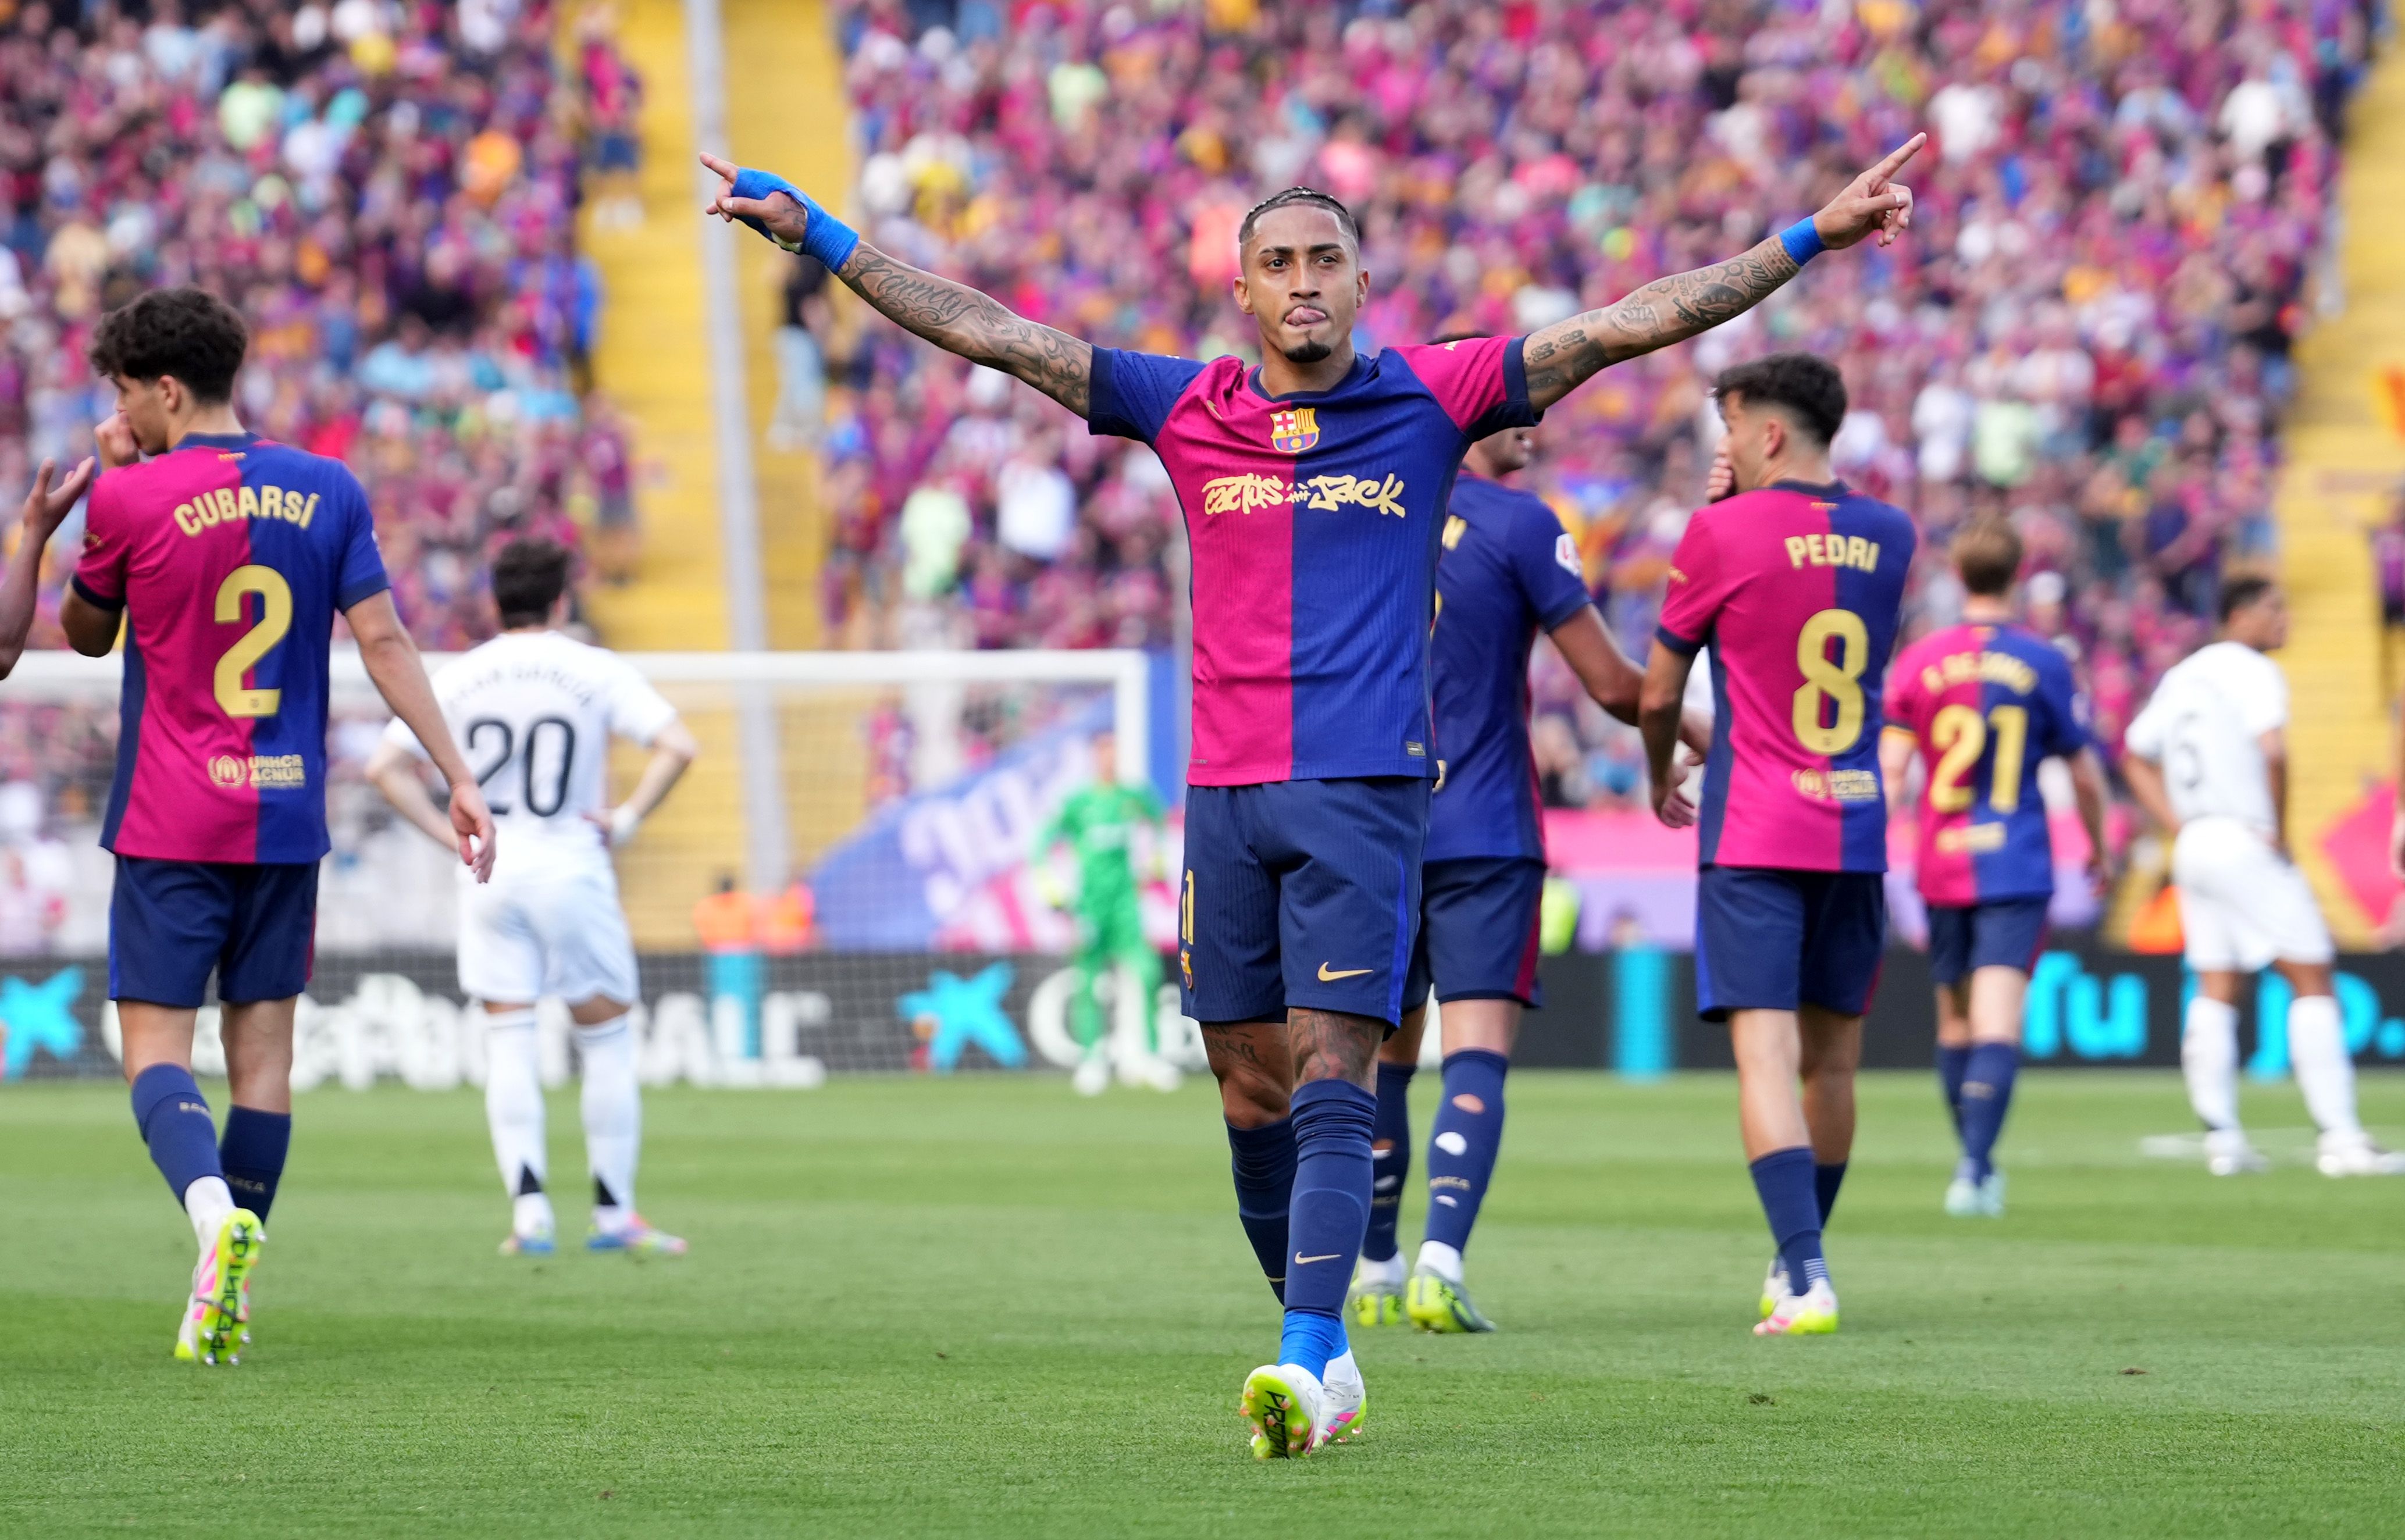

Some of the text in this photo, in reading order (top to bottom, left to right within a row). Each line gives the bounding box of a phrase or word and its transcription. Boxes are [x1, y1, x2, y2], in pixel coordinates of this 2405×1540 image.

[174, 484, 320, 536] CUBARSÍ
[1307, 473, 1406, 518] Jack
[1784, 533, 1880, 573] PEDRI
[213, 565, 293, 717] 2
[1792, 608, 1869, 755] 8
[467, 715, 575, 817] 20
[1929, 704, 2029, 815] 21
